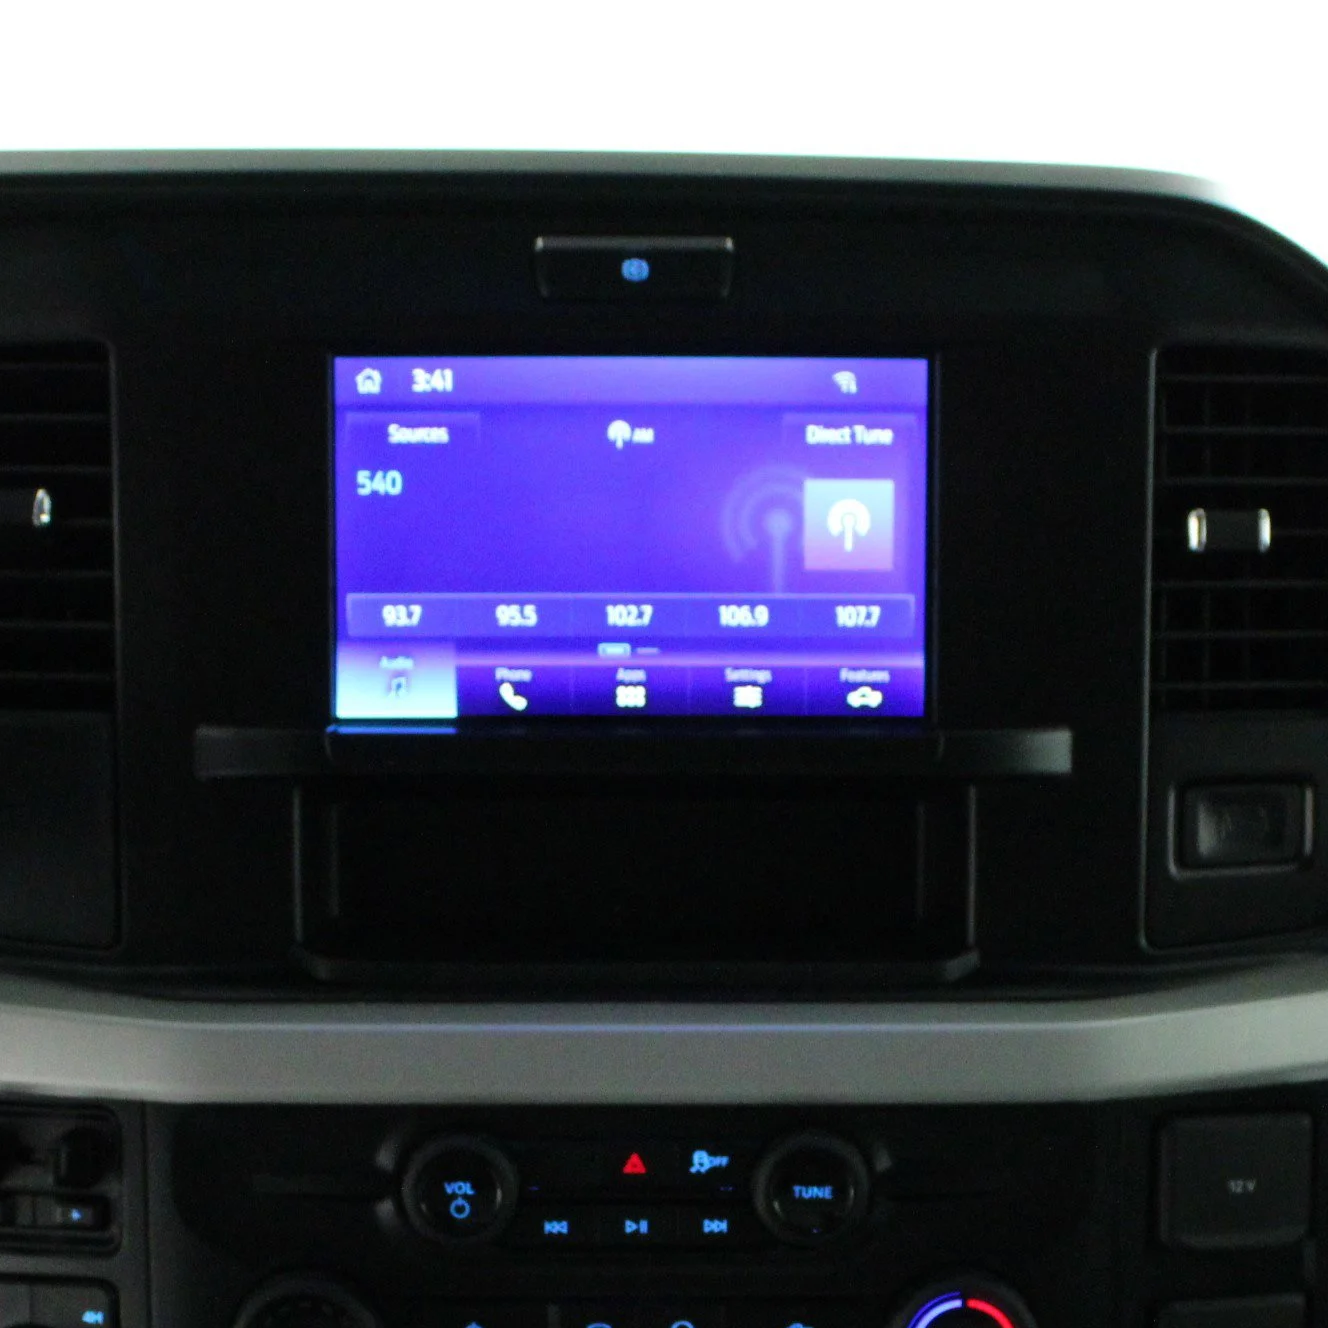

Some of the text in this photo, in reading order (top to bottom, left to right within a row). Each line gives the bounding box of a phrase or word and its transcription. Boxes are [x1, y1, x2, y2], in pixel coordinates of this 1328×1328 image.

[411, 368, 454, 393] 3:41
[387, 423, 449, 445] Sources
[632, 425, 654, 444] AM
[805, 422, 894, 446] Direct Tune
[356, 470, 403, 496] 540
[382, 604, 422, 627] 93.7
[495, 604, 538, 627] 95.5
[606, 604, 653, 627] 102.7
[719, 604, 769, 628] 106.9
[835, 604, 881, 628] 107.7
[495, 668, 532, 683] Phone
[725, 668, 774, 685] Settings
[840, 668, 890, 684] Features
[708, 1154, 729, 1168] OFF
[444, 1181, 474, 1195] VOL
[792, 1185, 834, 1200] TUNE
